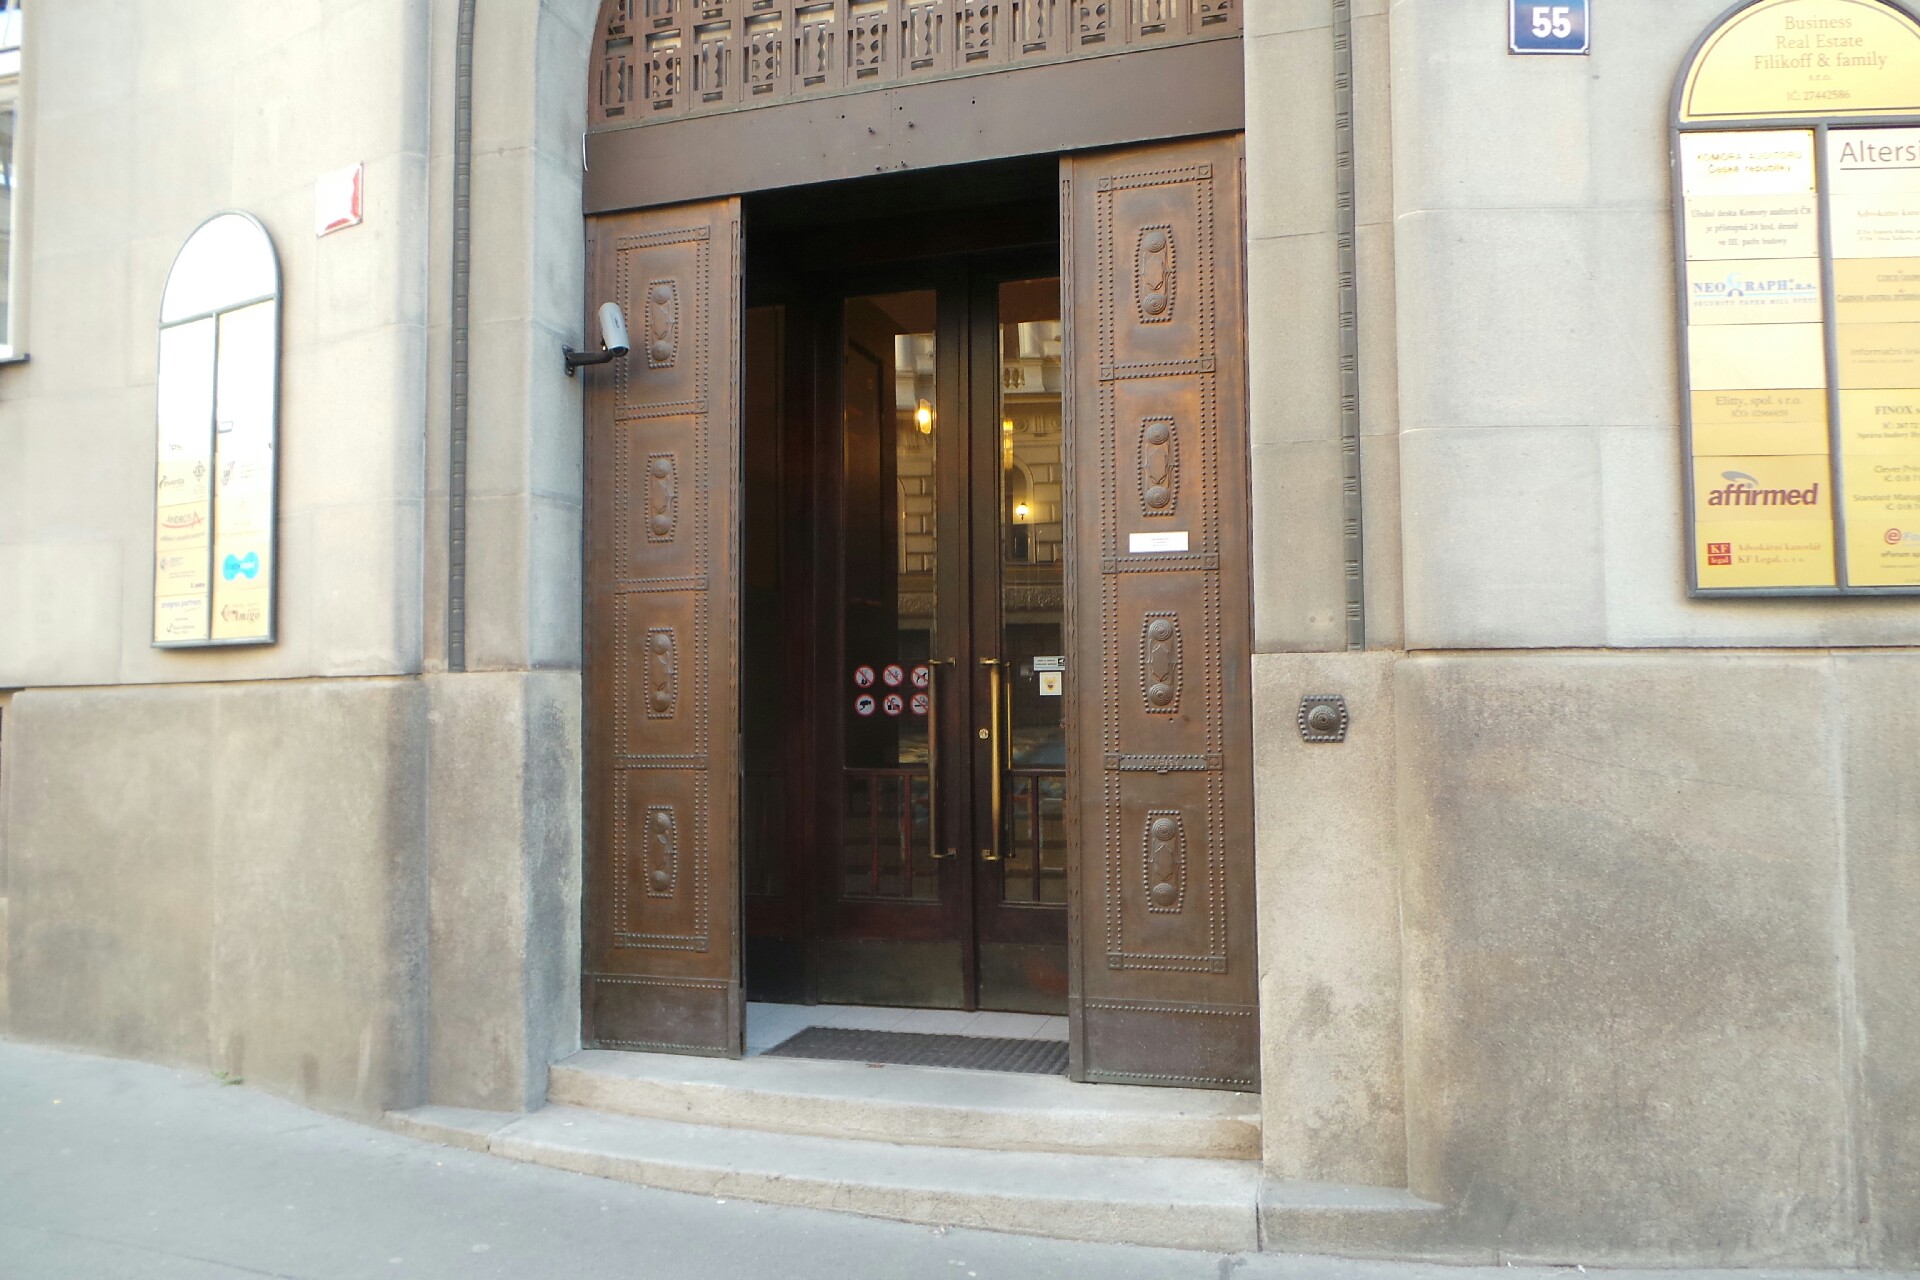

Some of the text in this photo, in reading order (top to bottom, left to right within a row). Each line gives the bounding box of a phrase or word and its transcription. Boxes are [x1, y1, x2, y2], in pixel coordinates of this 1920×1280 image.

[1531, 6, 1571, 39] 55
[1785, 15, 1853, 30] Business
[1776, 34, 1864, 50] Real Estate
[1754, 51, 1888, 70] Filikoff & family
[1875, 405, 1913, 415] FINOX
[1707, 482, 1819, 506] affirmed
[1710, 544, 1729, 554] KF
[1710, 555, 1729, 564] legal
